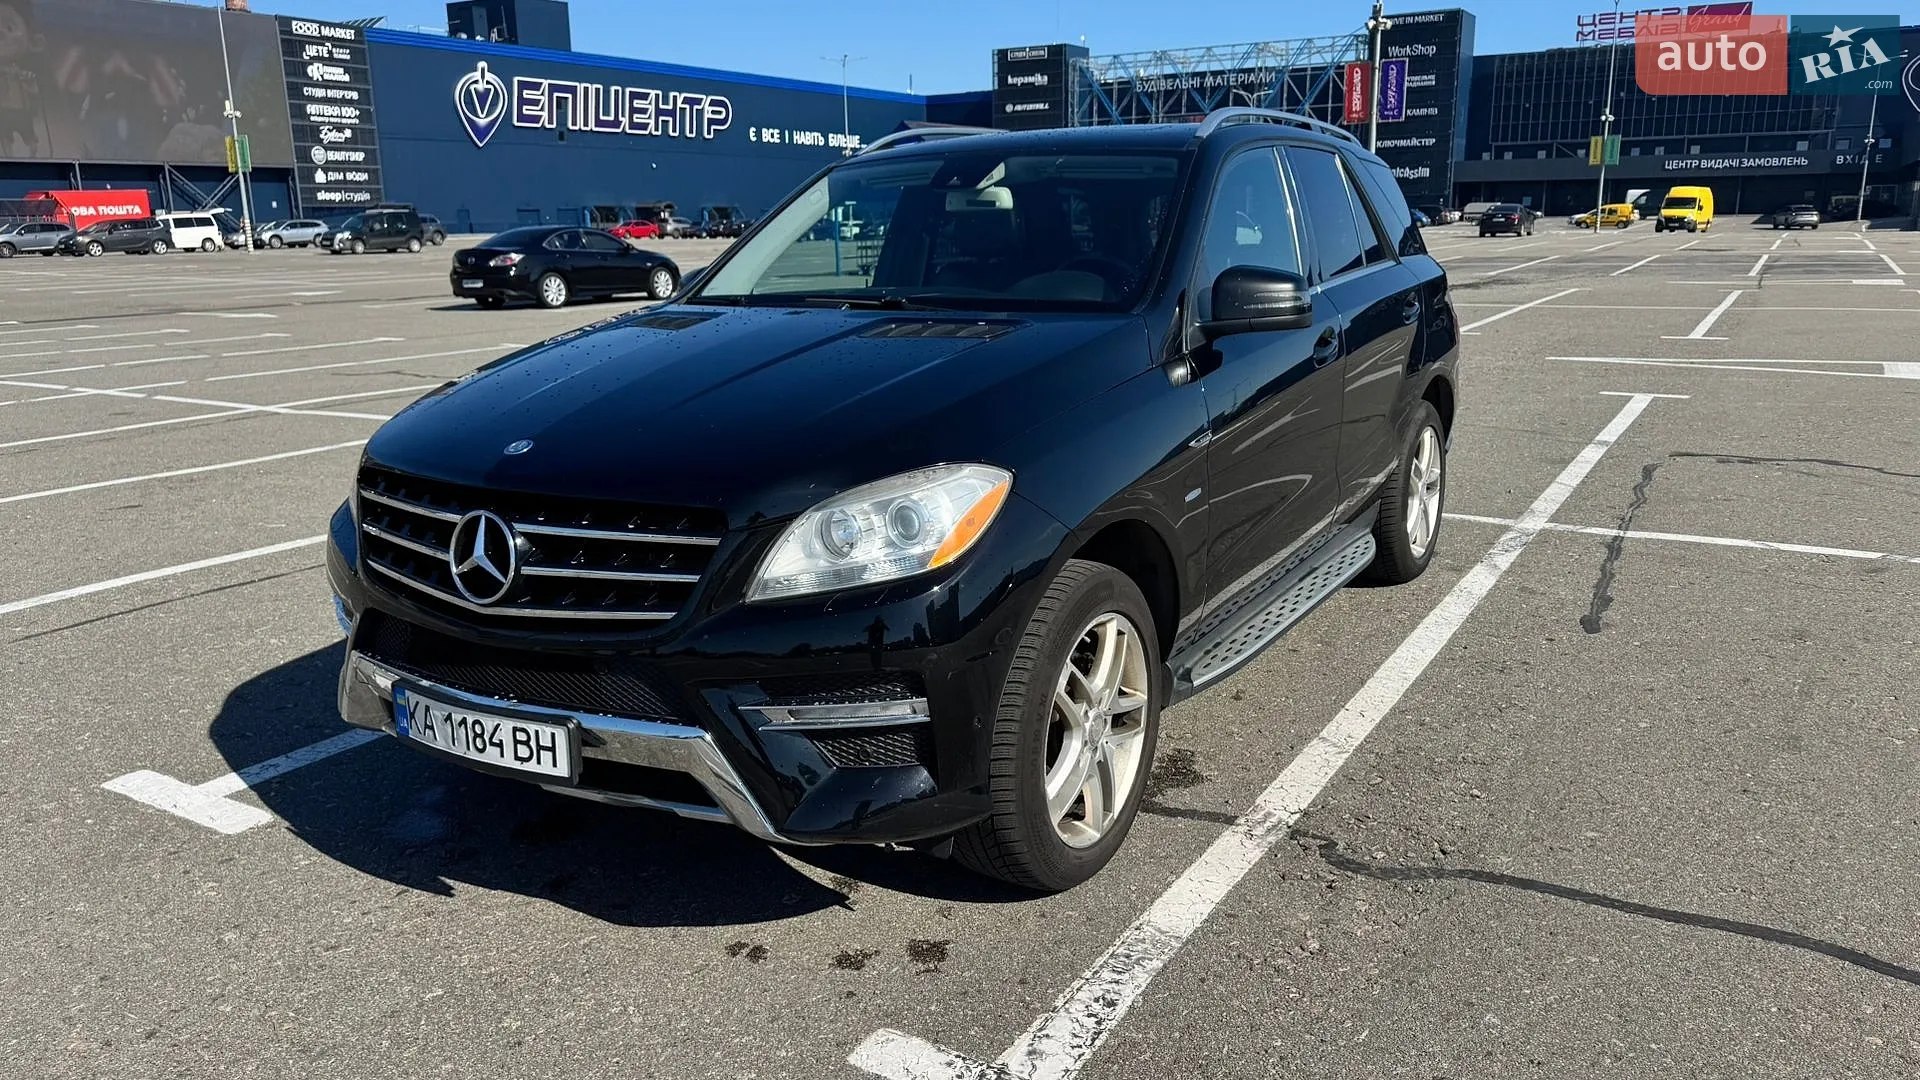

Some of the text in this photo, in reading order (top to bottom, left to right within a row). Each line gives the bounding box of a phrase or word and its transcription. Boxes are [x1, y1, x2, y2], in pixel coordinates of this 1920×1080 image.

[1577, 7, 1681, 28] ЦЕНТР
[292, 20, 355, 40] FOOD MARKET
[1576, 23, 1680, 42] МЕБЛІВ
[1388, 44, 1437, 57] WorkShop
[1136, 72, 1276, 92] БУДІВЕЛЬНІ МАТЕРІАЛИ
[513, 76, 732, 139] ЕПІЦЕНТР
[749, 127, 757, 141] Є
[761, 128, 780, 143] ВСЕ
[785, 130, 789, 144] І
[793, 130, 825, 146] НАВІТЬ
[1664, 157, 1808, 170] ЦЕНТР ВИДАЧІ ЗАМОВЛЕНЬ
[97, 205, 142, 216] ПОШТА
[406, 697, 558, 768] KA 1184 BH
